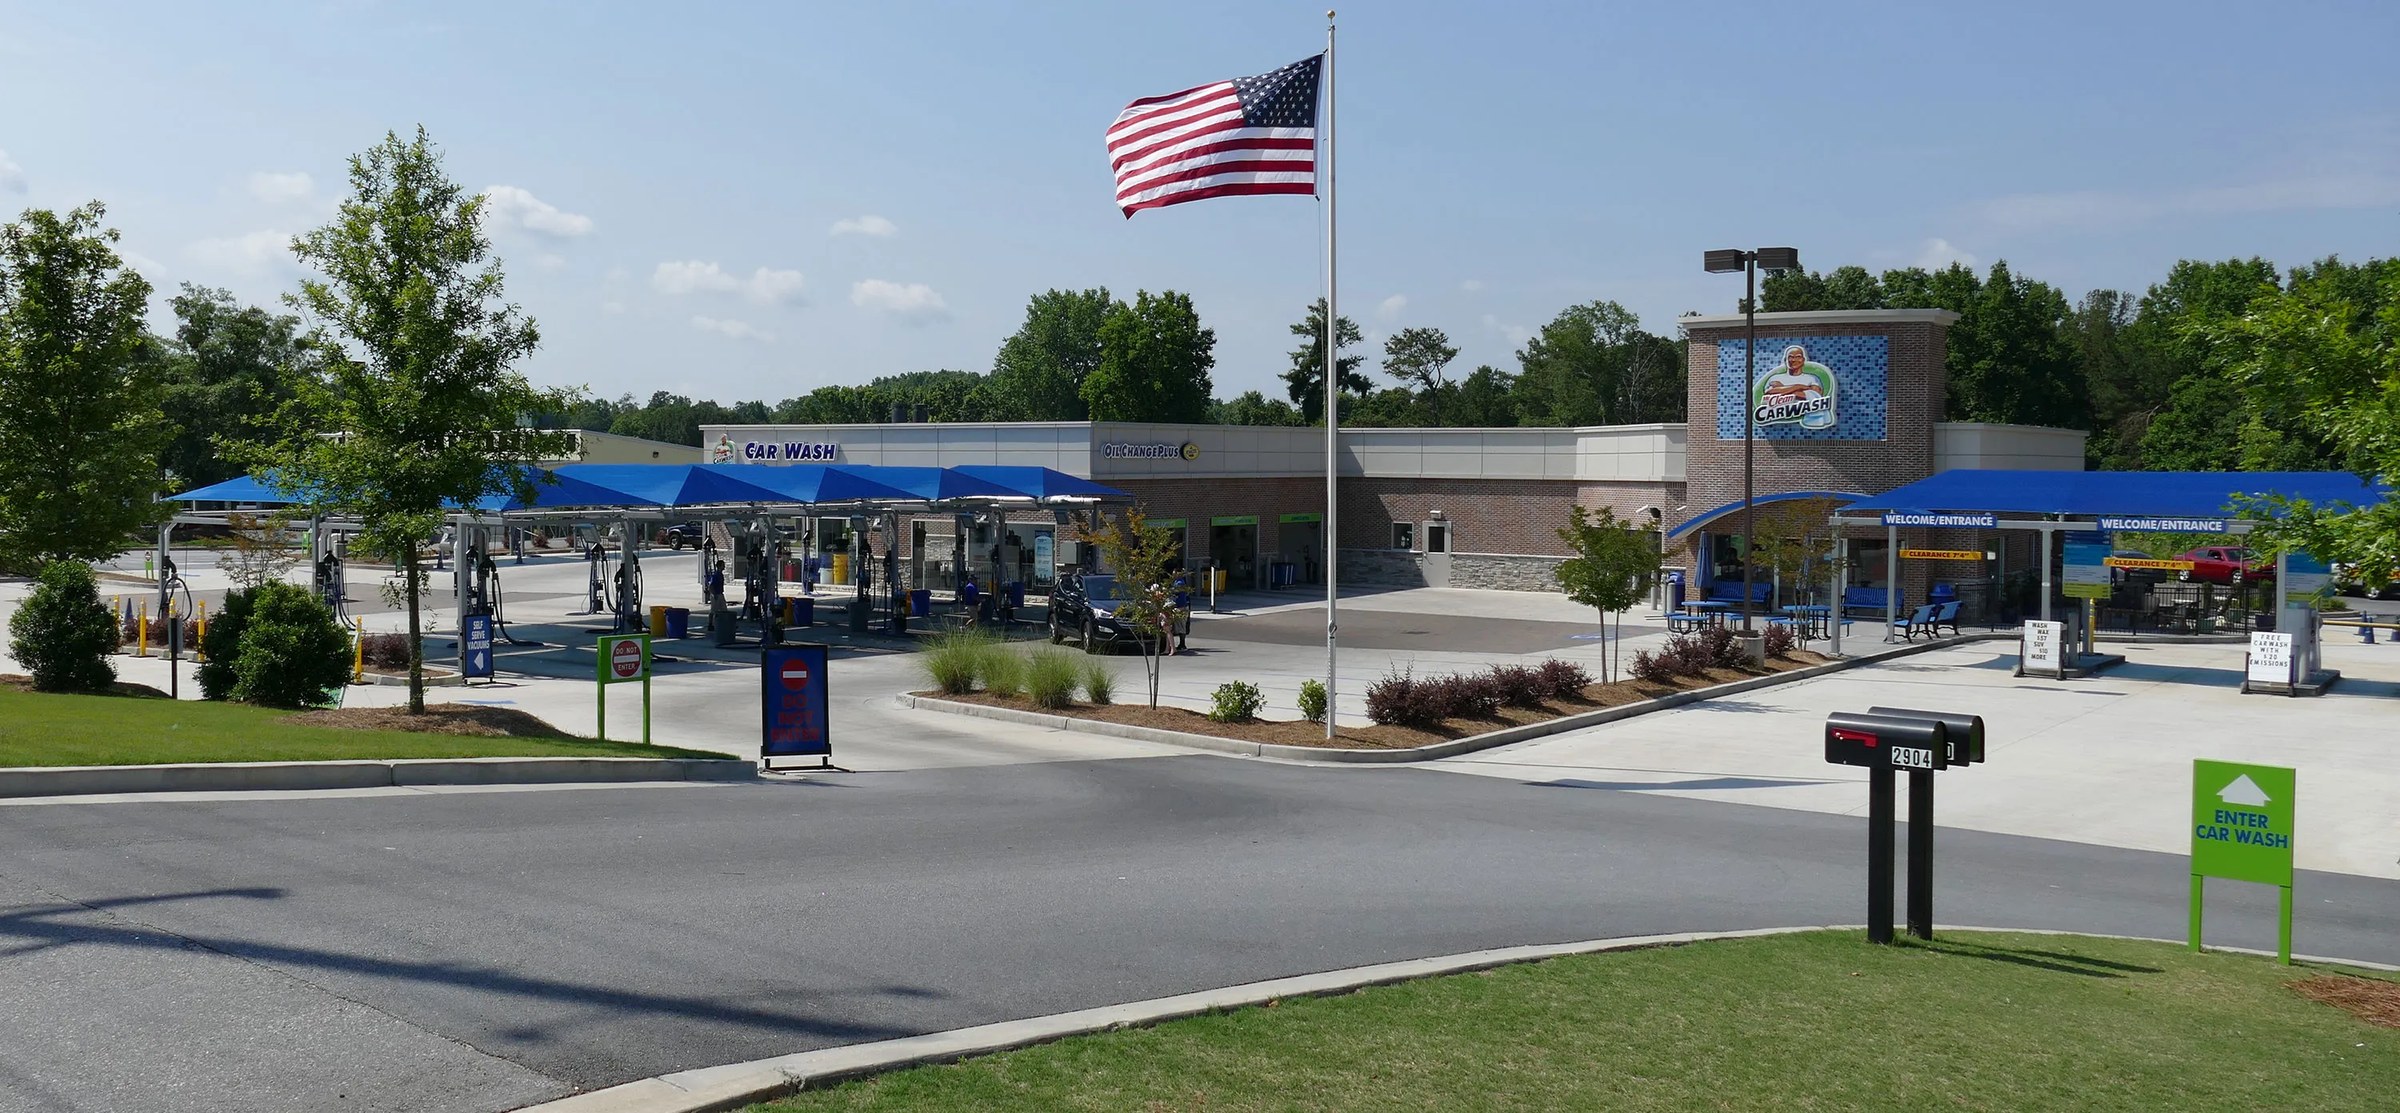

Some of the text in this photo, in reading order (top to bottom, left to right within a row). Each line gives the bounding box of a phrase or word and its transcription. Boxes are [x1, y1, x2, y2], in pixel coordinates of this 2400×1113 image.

[1769, 394, 1794, 407] Clean
[745, 441, 777, 460] CAR
[784, 441, 837, 461] WASH
[1885, 514, 1993, 526] WELCOME/ENTRANCE
[2101, 519, 2223, 531] WELCOME/ENTRANCE
[2114, 559, 2160, 567] CLEARANCE
[473, 620, 483, 630] SELF
[471, 630, 485, 640] SERVE
[467, 640, 490, 650] VACUUMS
[626, 646, 638, 654] NOT
[618, 663, 636, 671] ENTER
[2250, 659, 2288, 667] EMISSIONS
[1893, 747, 1930, 767] 2904
[2215, 809, 2269, 829] ENTER
[2196, 824, 2289, 849] CAR WASH
